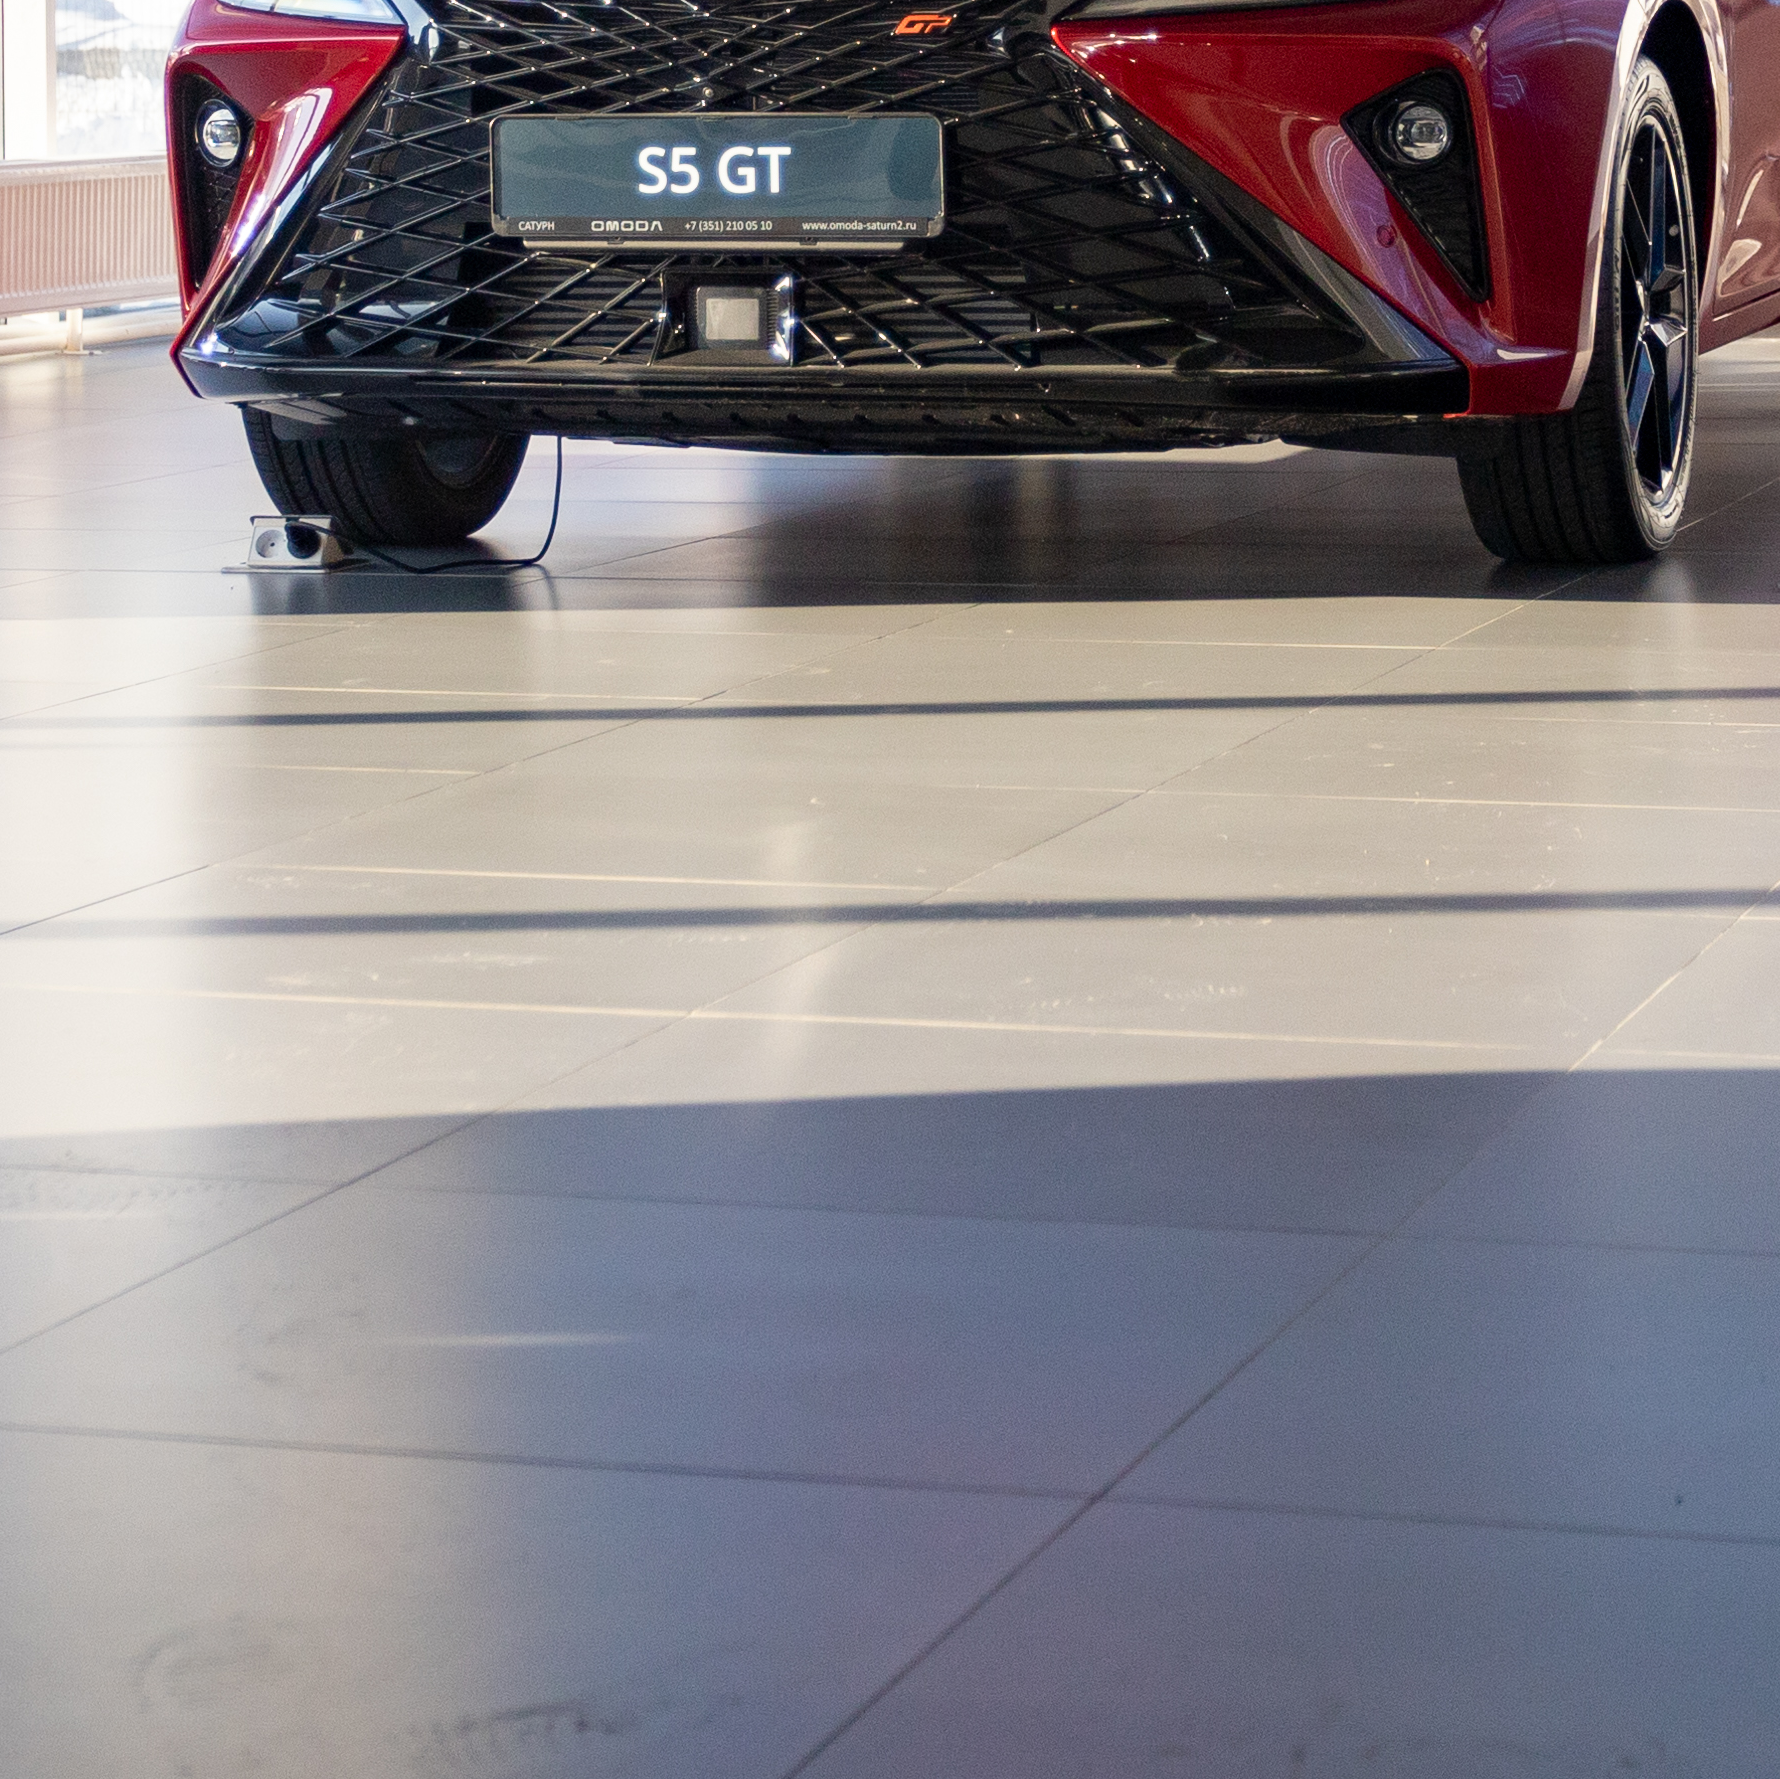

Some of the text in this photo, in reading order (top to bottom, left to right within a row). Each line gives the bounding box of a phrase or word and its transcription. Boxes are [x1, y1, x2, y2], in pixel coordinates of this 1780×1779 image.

[638, 146, 792, 194] S5 GT
[518, 220, 555, 231] САТУРН
[591, 220, 663, 232] OMODA
[684, 220, 772, 233] +7 (351) 210 05 10
[802, 220, 917, 231] www.omoda-saturn2.ru
